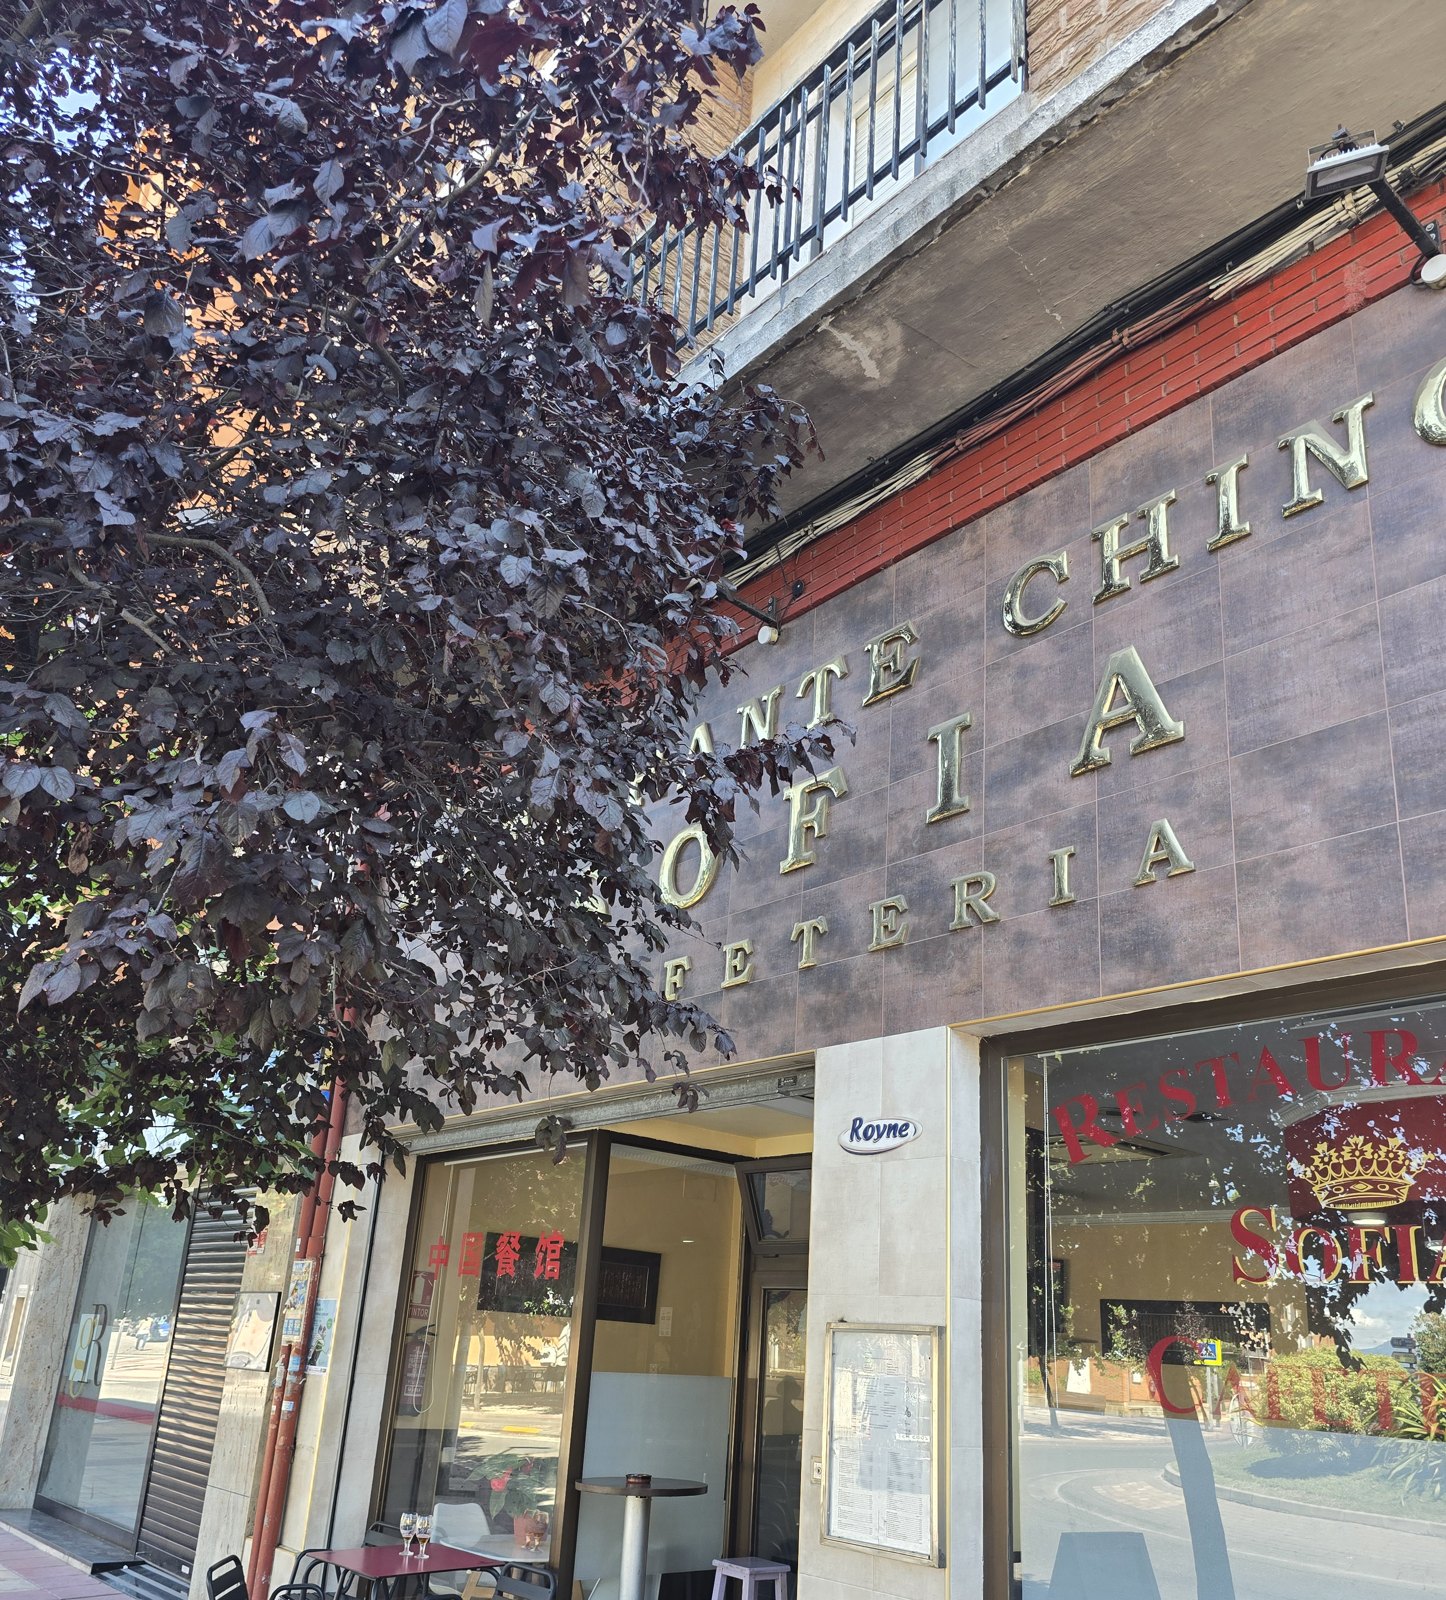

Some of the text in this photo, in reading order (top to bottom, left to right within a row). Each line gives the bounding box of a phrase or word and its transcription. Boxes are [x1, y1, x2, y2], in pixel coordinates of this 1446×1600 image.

[640, 622, 921, 792] ANTE
[577, 645, 1186, 922] OFIA
[664, 818, 1196, 1002] FETERIA
[849, 1116, 910, 1143] Royne
[1051, 1028, 1446, 1164] RESTAUR
[428, 1228, 565, 1281] 中国餐馆
[1230, 1205, 1446, 1285] SOFI
